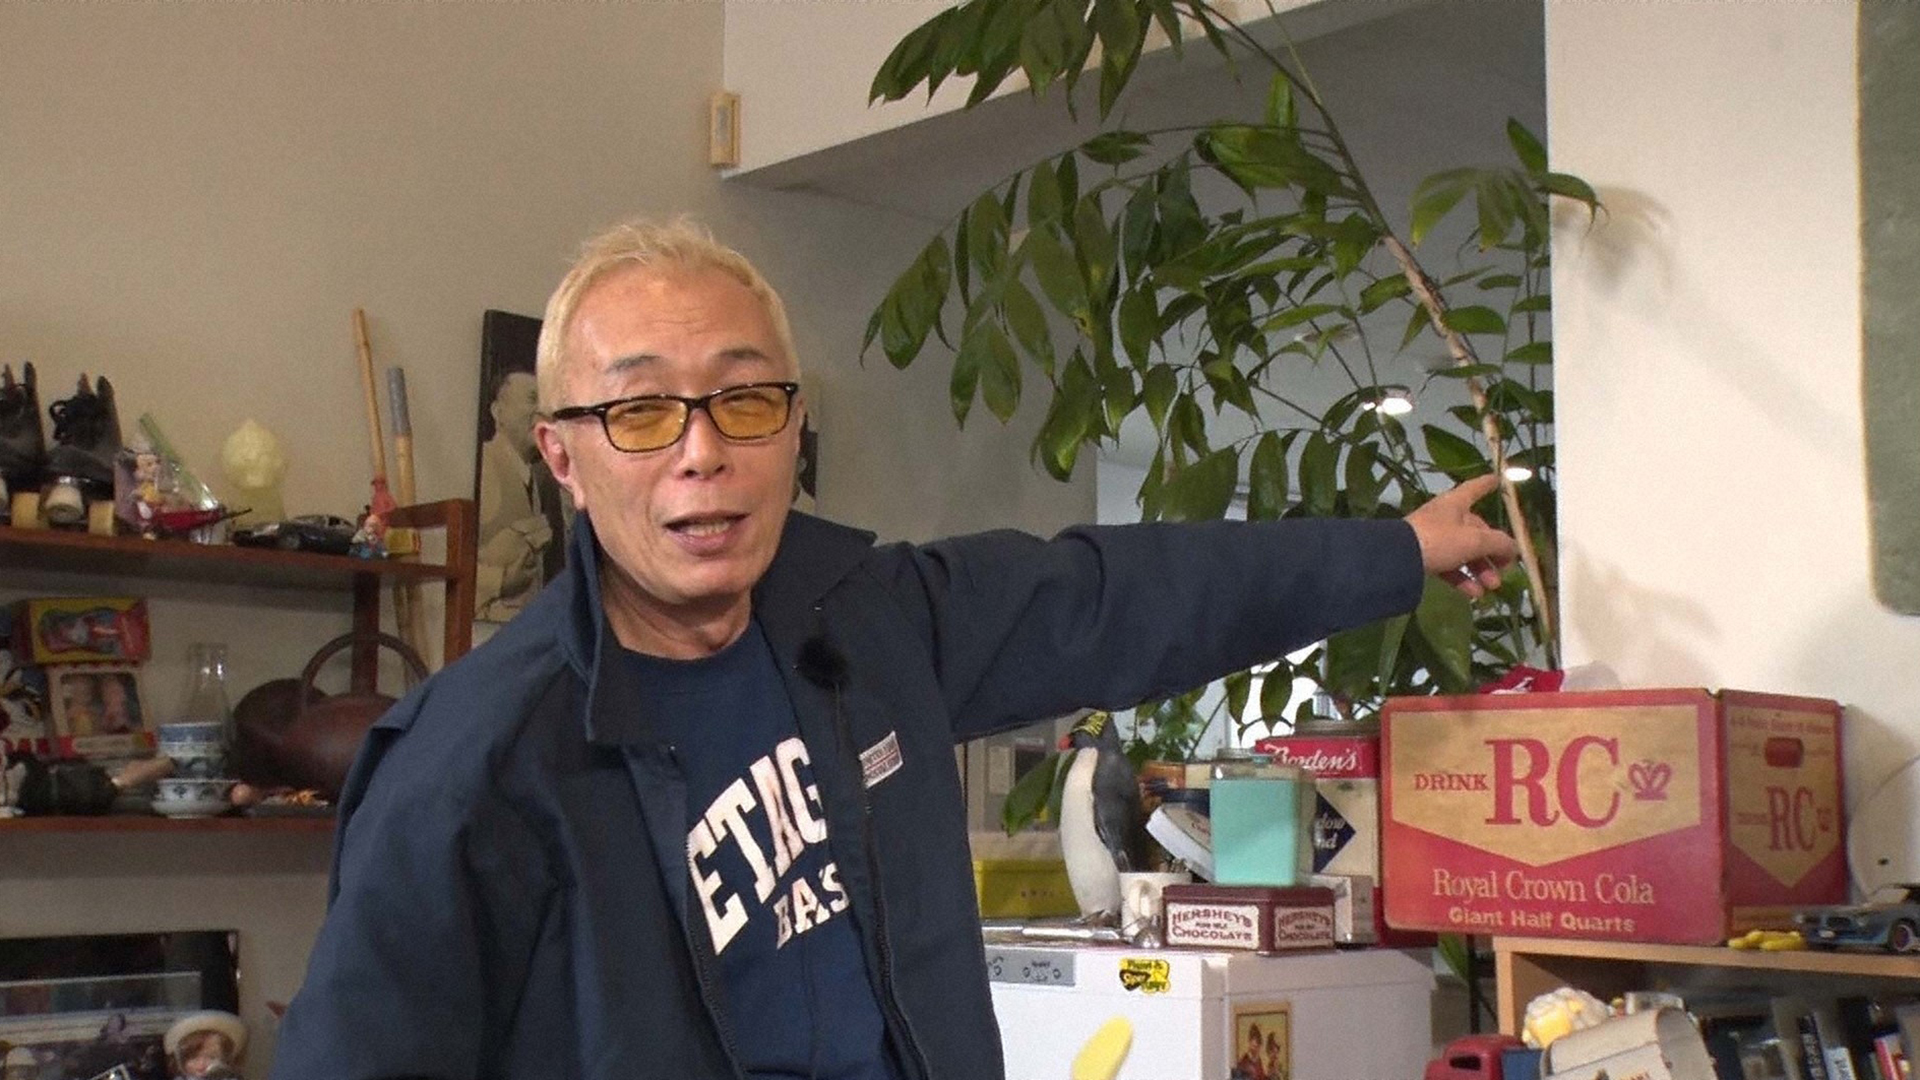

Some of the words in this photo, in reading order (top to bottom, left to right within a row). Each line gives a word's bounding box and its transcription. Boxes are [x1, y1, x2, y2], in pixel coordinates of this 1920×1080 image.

[1414, 773, 1490, 792] DRINK
[1484, 735, 1621, 829] RC
[1766, 786, 1817, 852] RC
[773, 862, 850, 949] BAS
[1433, 868, 1498, 905] Royal
[1506, 870, 1587, 903] Crown
[1595, 873, 1655, 906] Cola
[1172, 927, 1253, 941] CHOCOLATE
[1449, 906, 1504, 928] Giant
[1511, 910, 1552, 930] Half
[1560, 911, 1636, 933] Quarts
